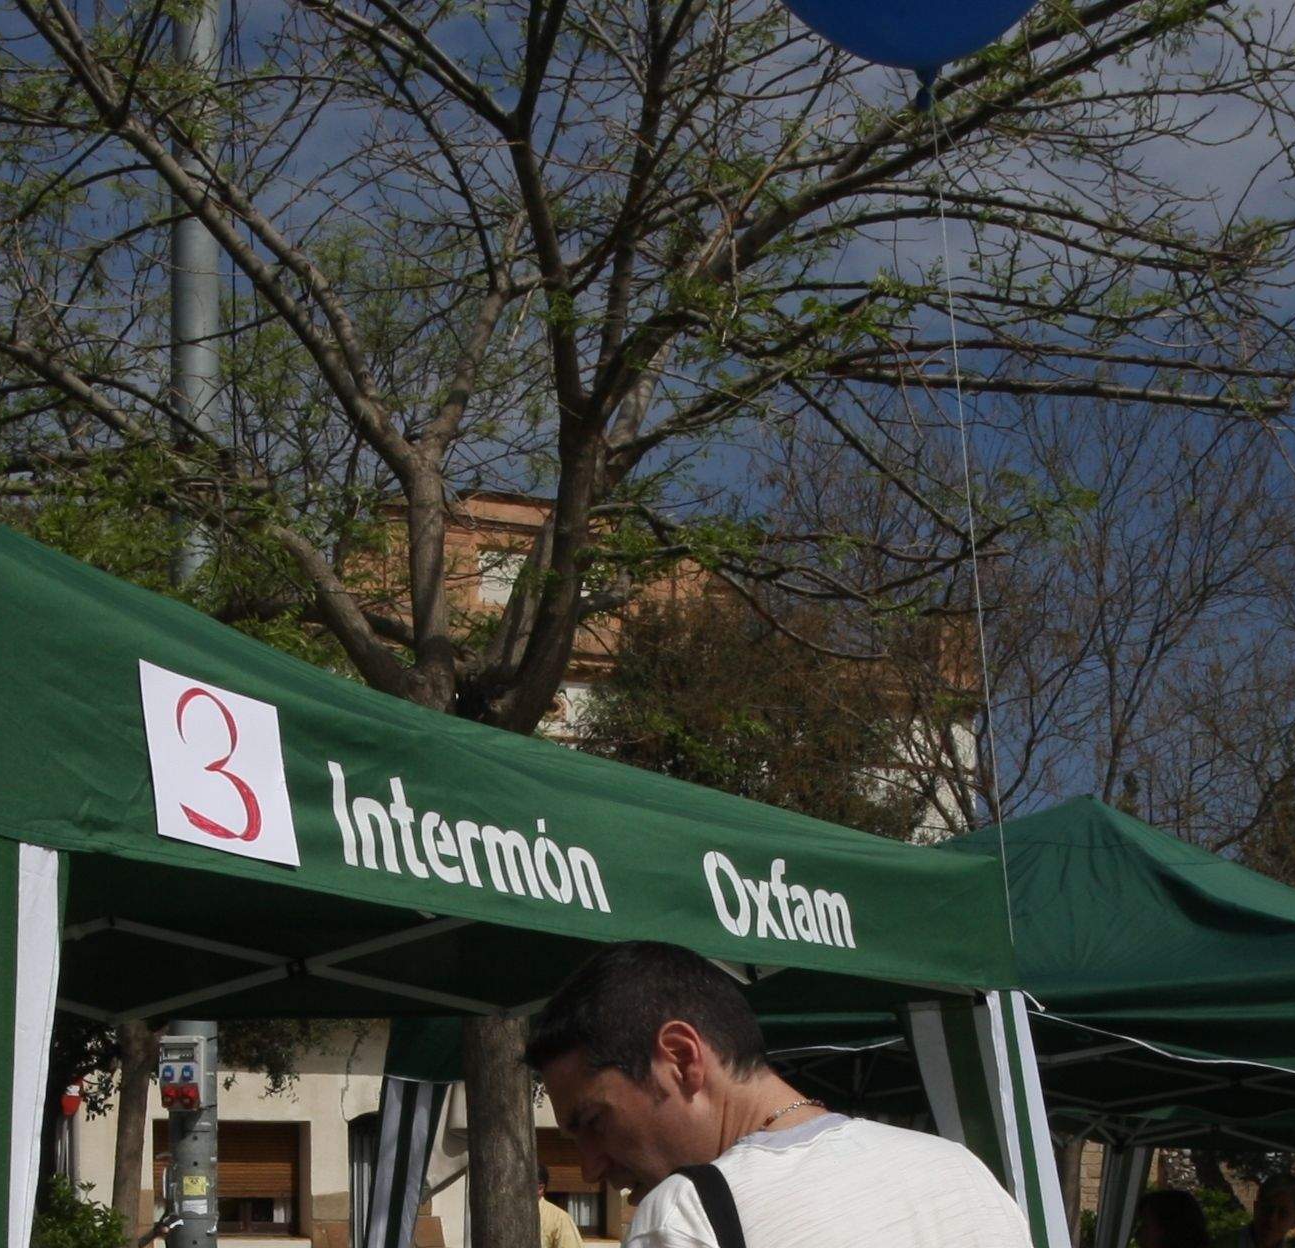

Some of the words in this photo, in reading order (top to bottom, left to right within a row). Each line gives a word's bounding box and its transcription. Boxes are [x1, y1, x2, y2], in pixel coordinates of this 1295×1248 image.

[176, 687, 262, 842] 3
[328, 760, 612, 913] Intermón
[703, 851, 857, 949] Oxfam
